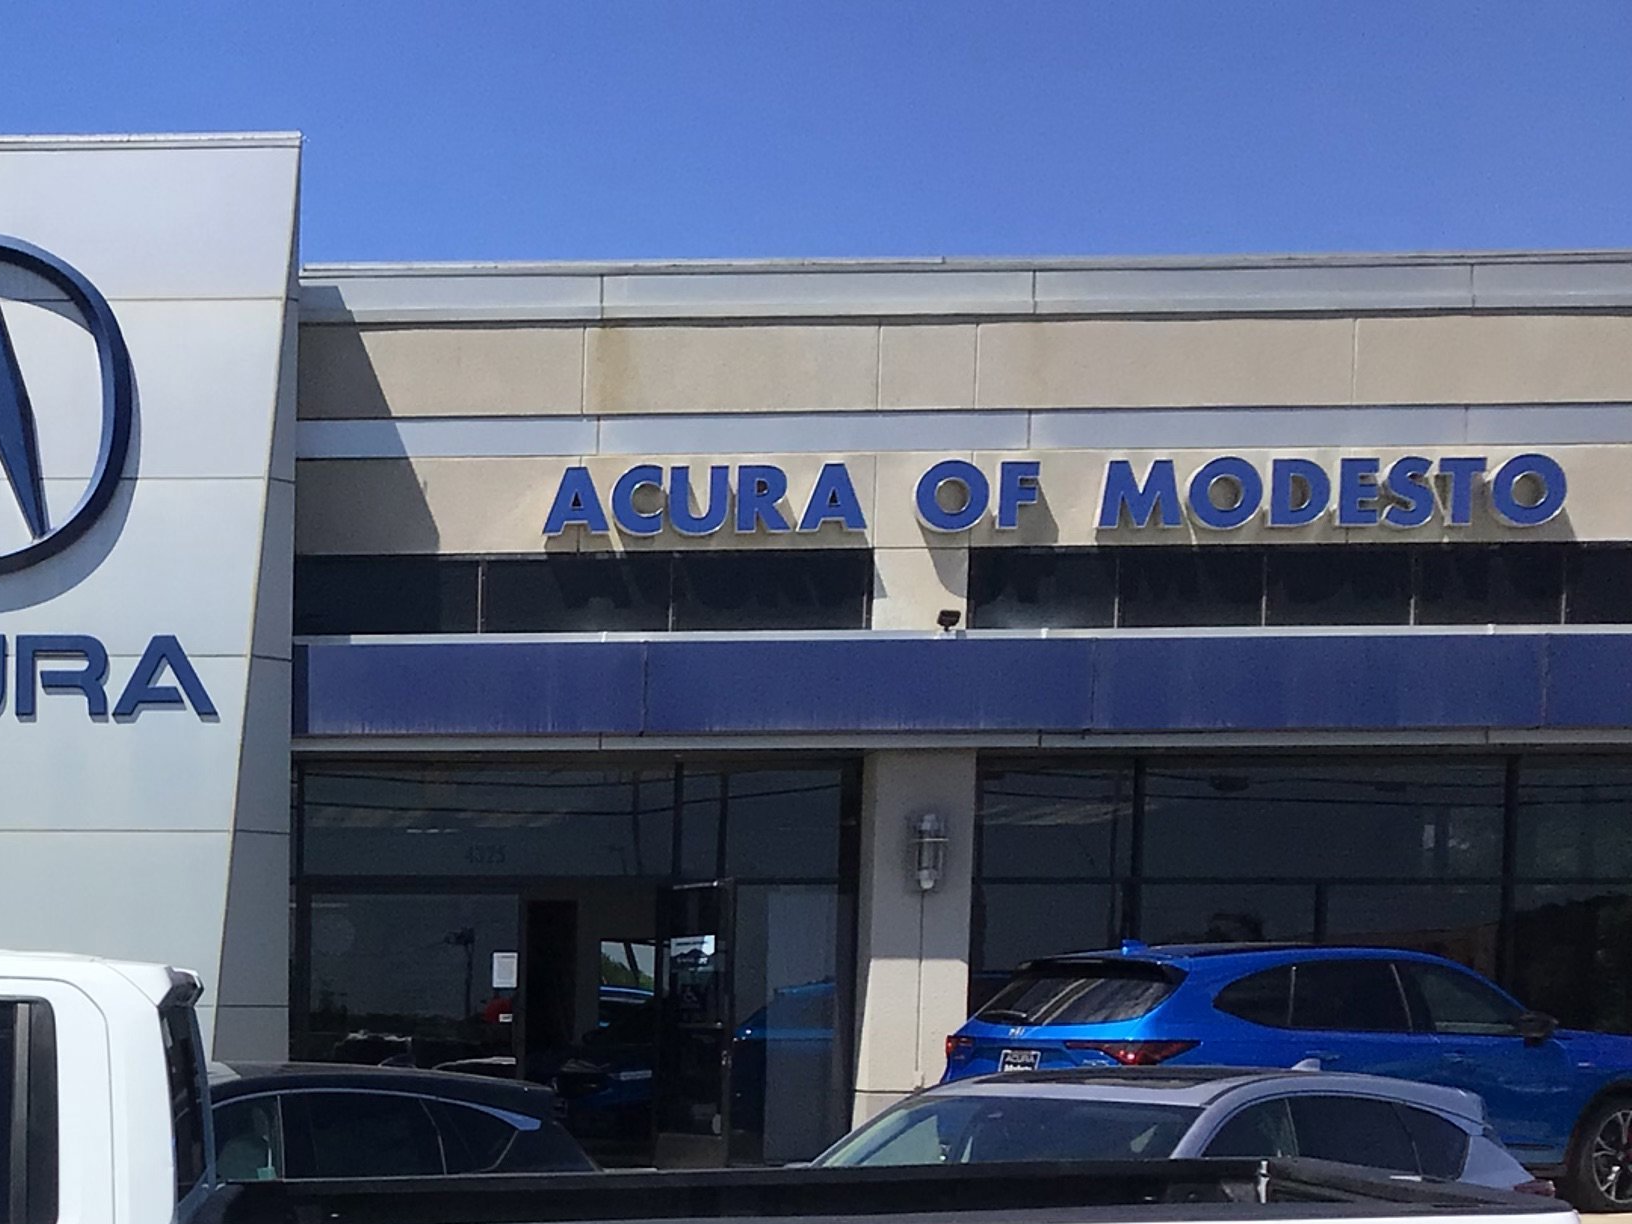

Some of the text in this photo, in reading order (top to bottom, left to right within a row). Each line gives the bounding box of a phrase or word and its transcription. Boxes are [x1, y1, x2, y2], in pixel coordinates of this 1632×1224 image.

[542, 452, 1568, 536] ACURA OF MODESTO
